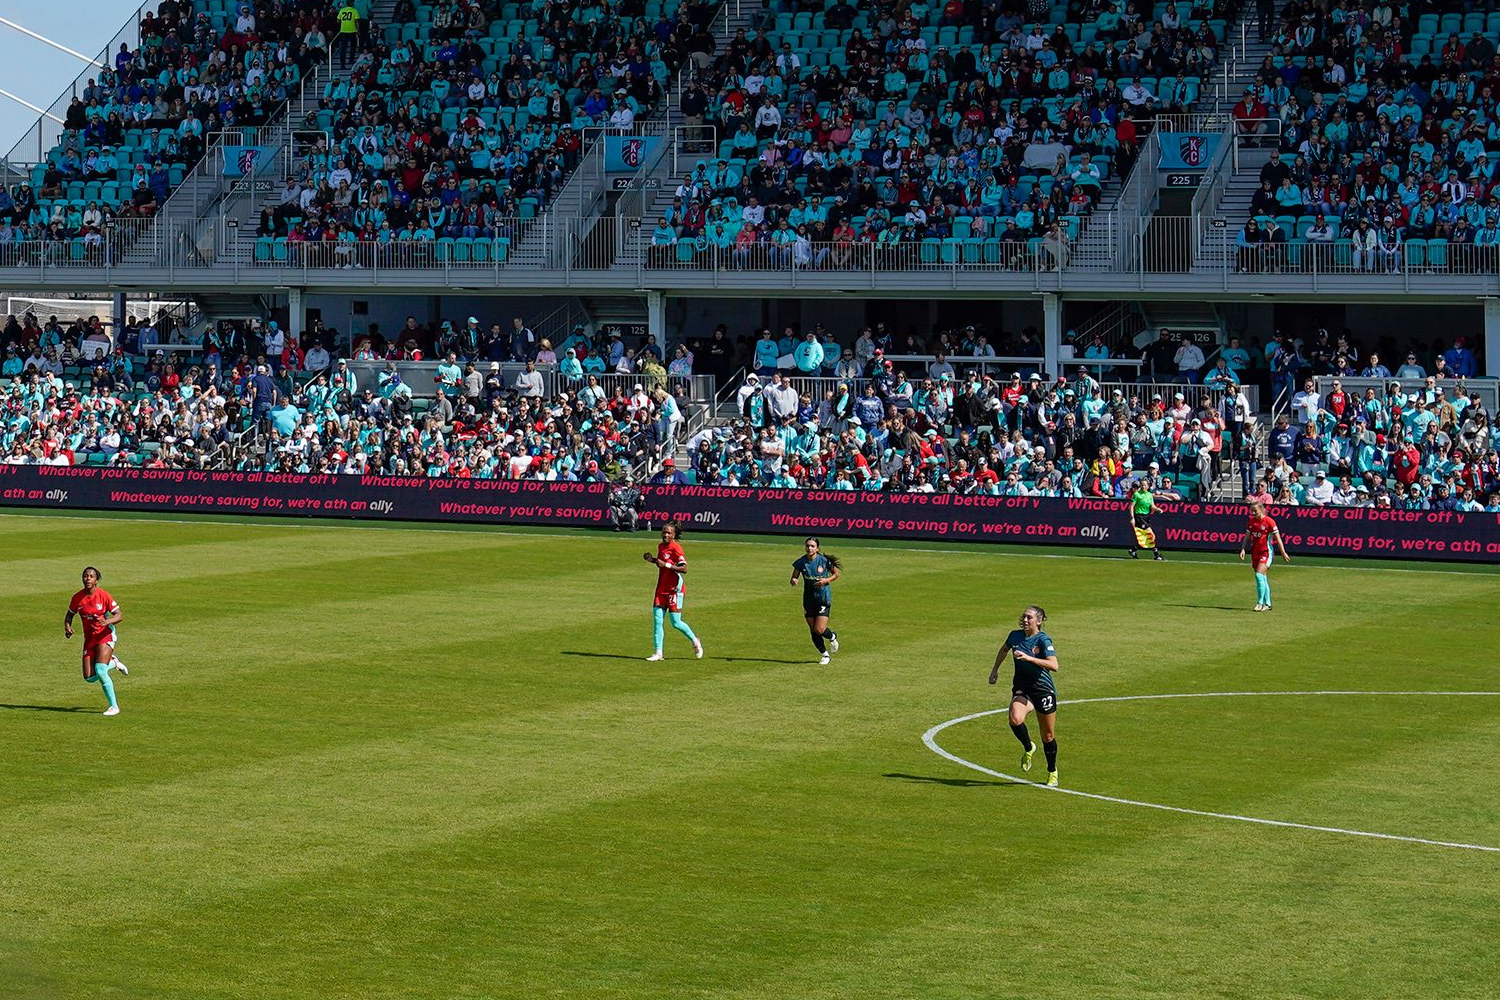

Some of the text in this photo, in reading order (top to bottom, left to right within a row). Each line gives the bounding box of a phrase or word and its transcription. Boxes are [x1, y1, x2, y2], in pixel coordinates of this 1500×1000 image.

[342, 12, 352, 21] 20
[646, 180, 657, 188] 25
[1172, 176, 1190, 185] 225
[631, 326, 645, 335] 125
[1170, 333, 1210, 342] 25 126
[39, 466, 329, 484] Whatever you're saving for, we're all better off
[361, 475, 425, 487] Whatever
[429, 478, 470, 490] you're
[474, 480, 519, 493] saving
[523, 480, 545, 492] for,
[550, 482, 585, 492] we're
[588, 483, 604, 493] all
[656, 485, 677, 495] off
[28, 490, 43, 499] an
[45, 489, 68, 502] ally.
[111, 491, 171, 503] Whatever
[175, 495, 213, 505] you're
[218, 497, 259, 509] saving
[263, 496, 283, 508] for,
[288, 498, 320, 508] we're
[351, 501, 367, 510] an
[369, 500, 394, 513] ally.
[758, 489, 803, 501] you're
[808, 491, 856, 504] saving
[861, 491, 884, 504] for,
[890, 493, 928, 504] we're
[932, 494, 950, 505] all
[953, 495, 1002, 507] better
[1006, 496, 1029, 507] off
[441, 503, 505, 514] Whatever
[510, 506, 551, 517] you're
[556, 508, 602, 521] saving
[1068, 498, 1129, 511] Whatev
[1297, 508, 1339, 519] we're
[1344, 509, 1363, 519] all
[1369, 510, 1423, 521] better
[1427, 513, 1453, 523] off
[674, 512, 691, 523] an
[694, 512, 720, 525] ally.
[772, 514, 842, 527] Whatever
[848, 518, 893, 530] you're
[898, 520, 948, 533] saving
[953, 521, 978, 534] for,
[983, 523, 1022, 534] we're
[1057, 526, 1077, 536] an
[1080, 526, 1109, 539] ally.
[1307, 536, 1363, 550] saving
[1369, 536, 1396, 550] for,
[1401, 539, 1445, 551] we're
